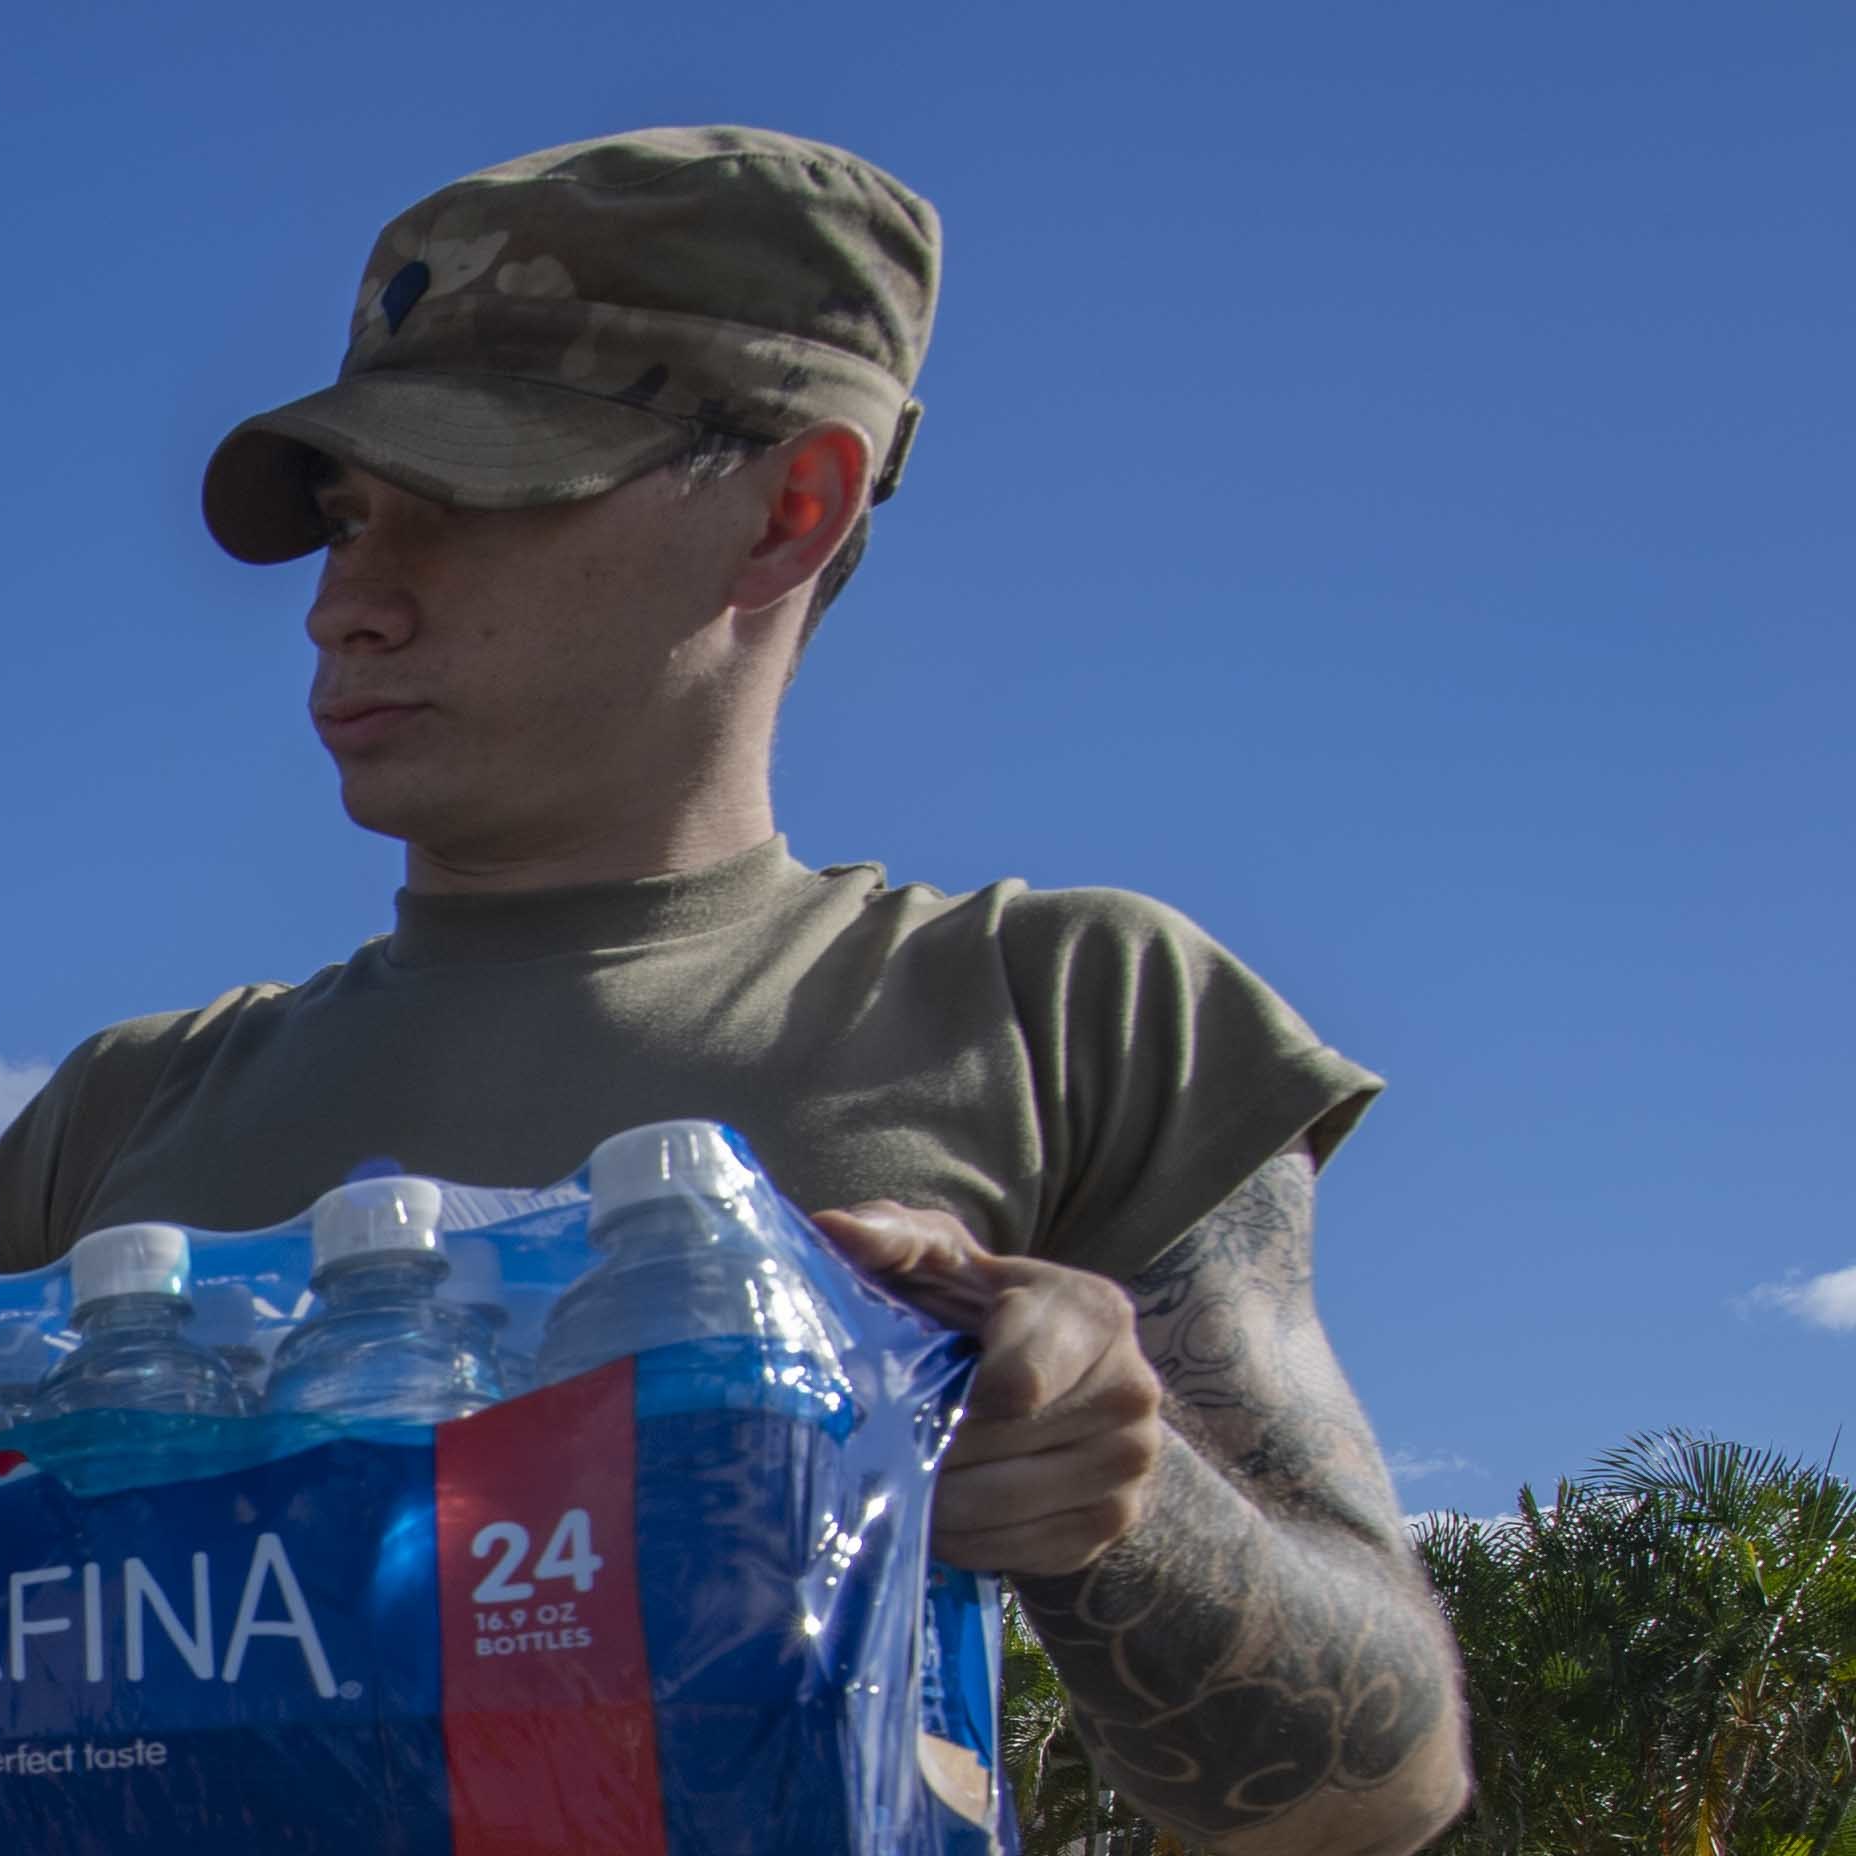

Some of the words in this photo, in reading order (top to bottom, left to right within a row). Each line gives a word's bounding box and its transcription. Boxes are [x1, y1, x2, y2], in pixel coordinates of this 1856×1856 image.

[471, 1508, 604, 1604] 24
[474, 1608, 528, 1632] 16.9
[536, 1601, 578, 1625] OZ
[475, 1627, 592, 1656] BOTTLES
[83, 1737, 168, 1772] taste
